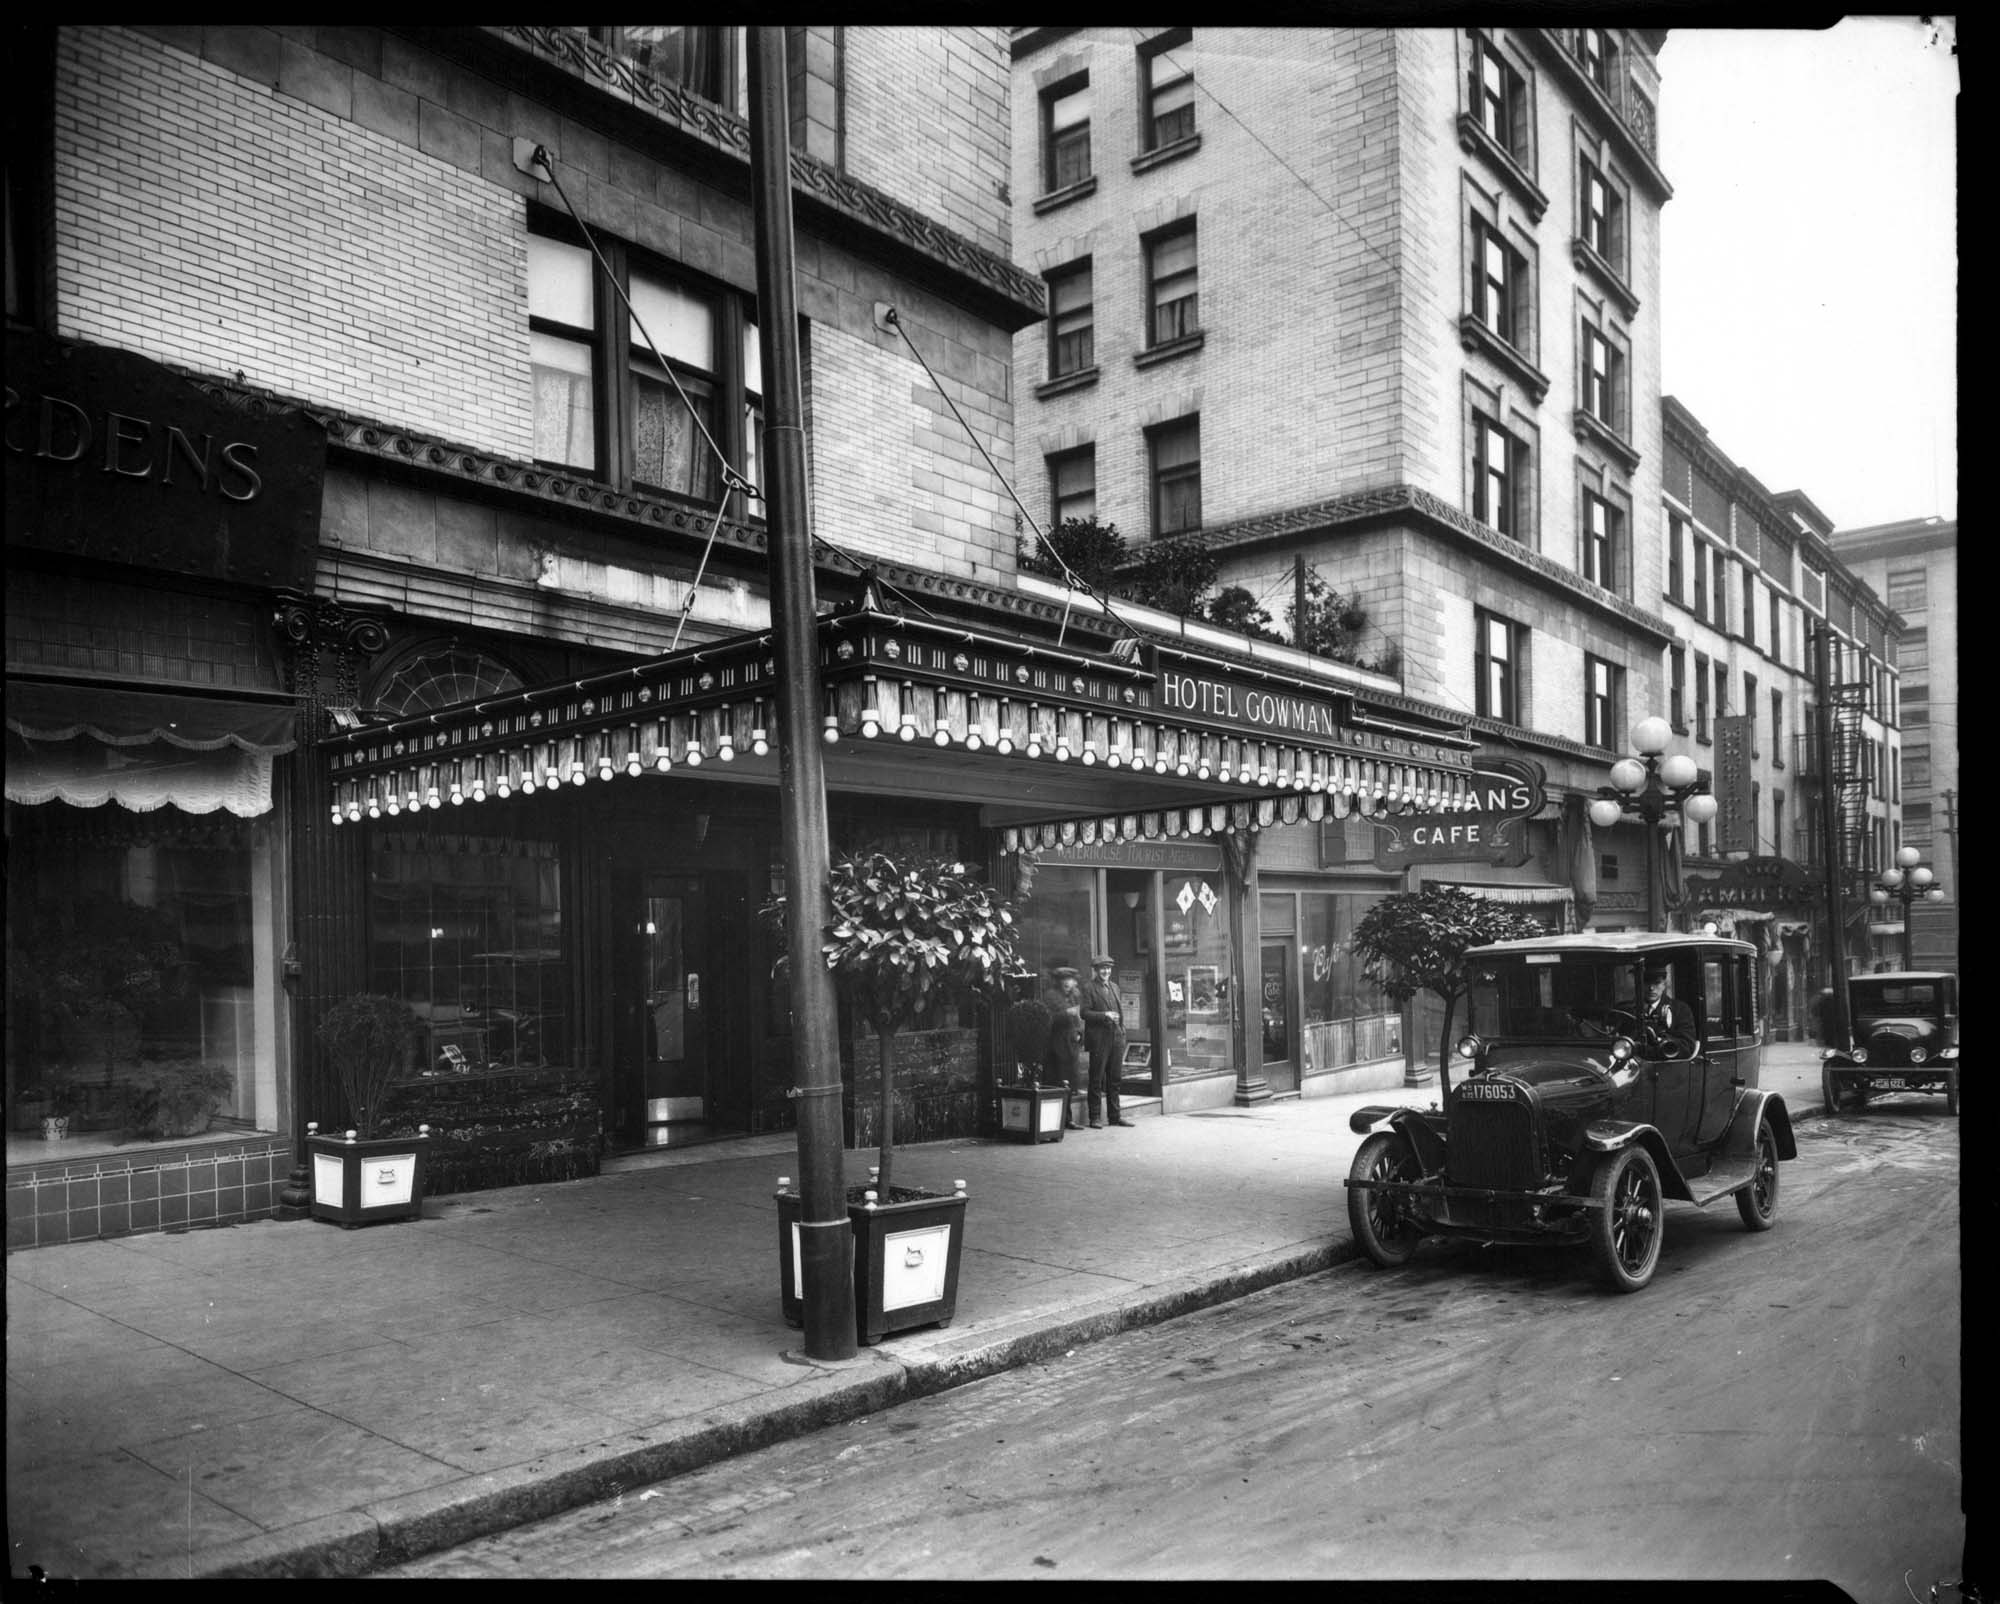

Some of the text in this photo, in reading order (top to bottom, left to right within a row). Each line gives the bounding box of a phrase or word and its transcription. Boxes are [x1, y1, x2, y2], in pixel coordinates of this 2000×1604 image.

[1164, 673, 1333, 736] HOTEL GOWMAN
[1413, 825, 1480, 845] CAFE
[1473, 1084, 1516, 1099] 176053
